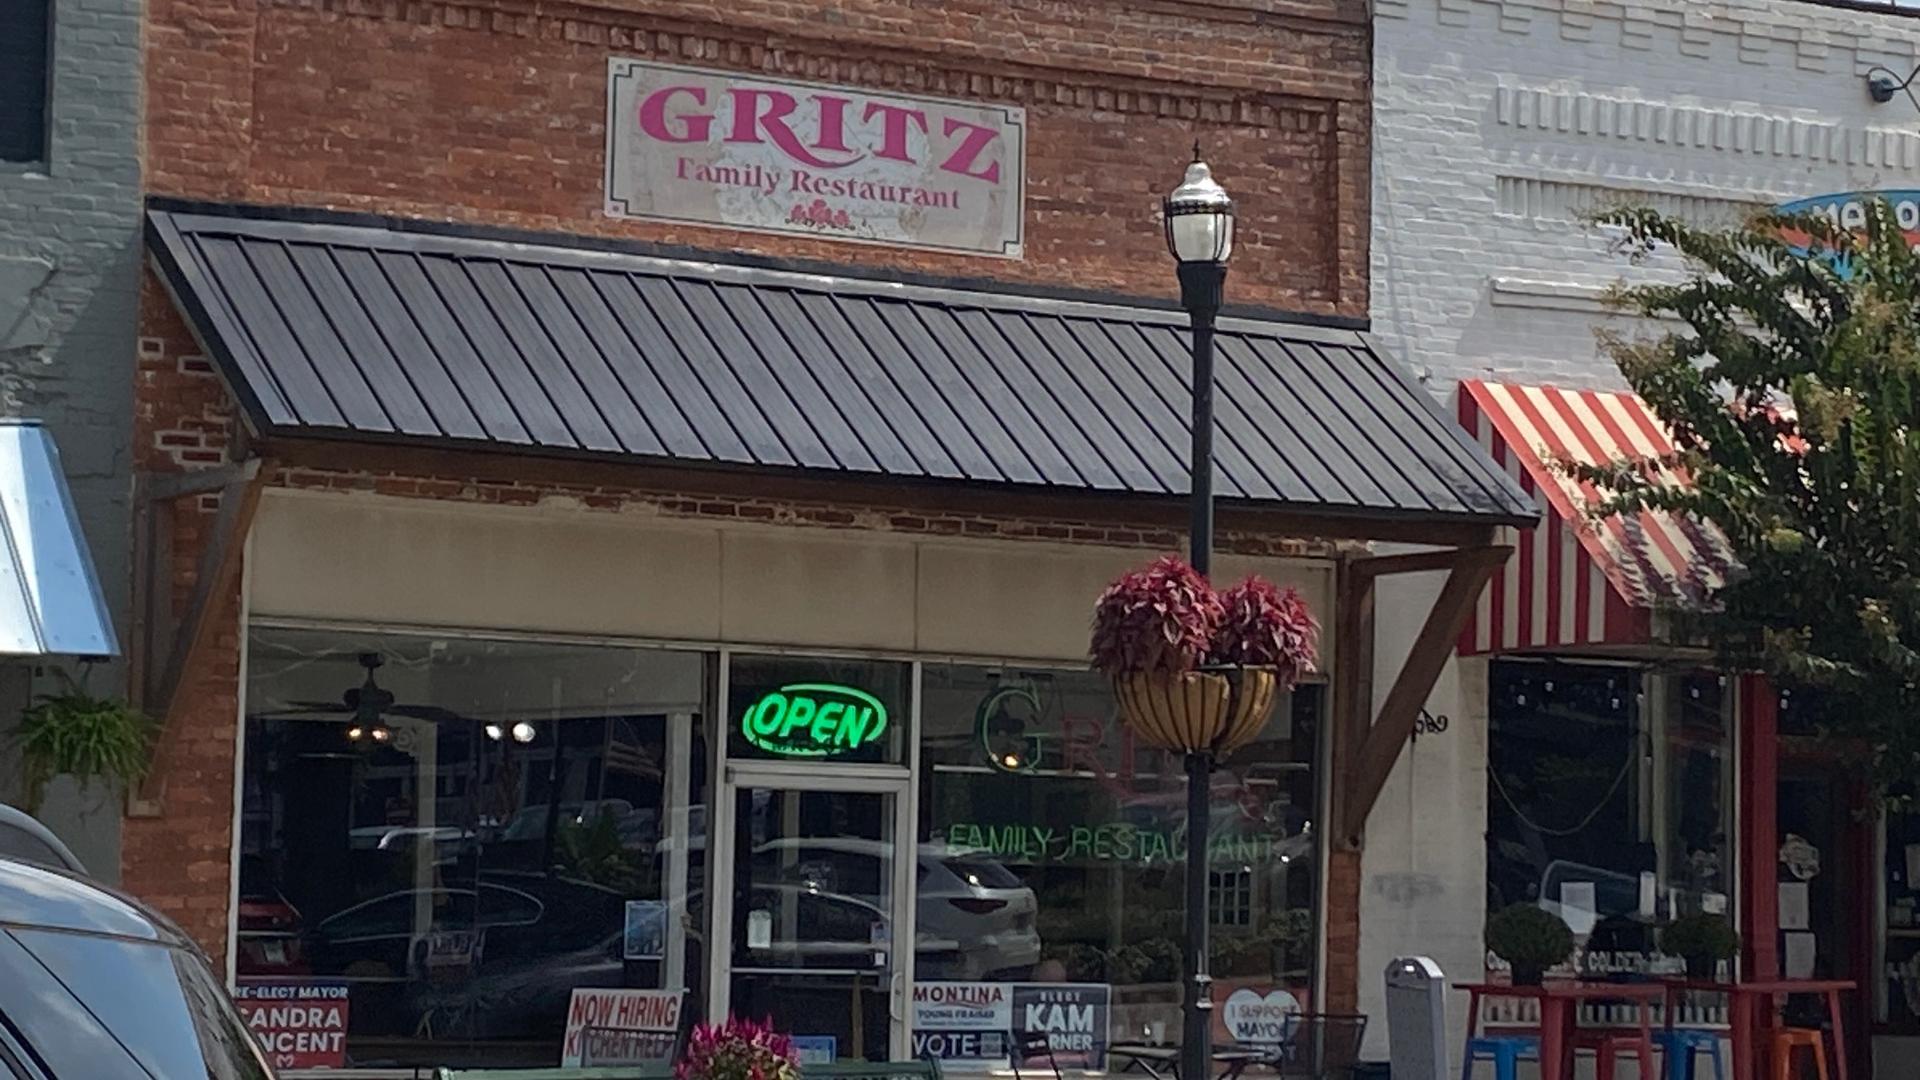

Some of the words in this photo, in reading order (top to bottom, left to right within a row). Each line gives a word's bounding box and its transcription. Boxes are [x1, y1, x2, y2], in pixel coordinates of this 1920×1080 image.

[639, 86, 999, 184] GRITZ
[676, 157, 780, 196] Family
[788, 169, 960, 209] Restaurant
[753, 692, 873, 748] OPEN
[948, 824, 1054, 859] FAMILY
[1068, 823, 1278, 862] RESTAUANT
[298, 986, 348, 998] MAYOR
[912, 985, 1004, 1002] MONTINA
[241, 1007, 342, 1028] ANDRA
[570, 994, 617, 1027] NOW
[616, 995, 678, 1027] HIRING
[1025, 1003, 1094, 1032] KAM
[1048, 1034, 1093, 1051] RNER
[1236, 1022, 1286, 1038] MAYO
[912, 1033, 977, 1057] VOTE
